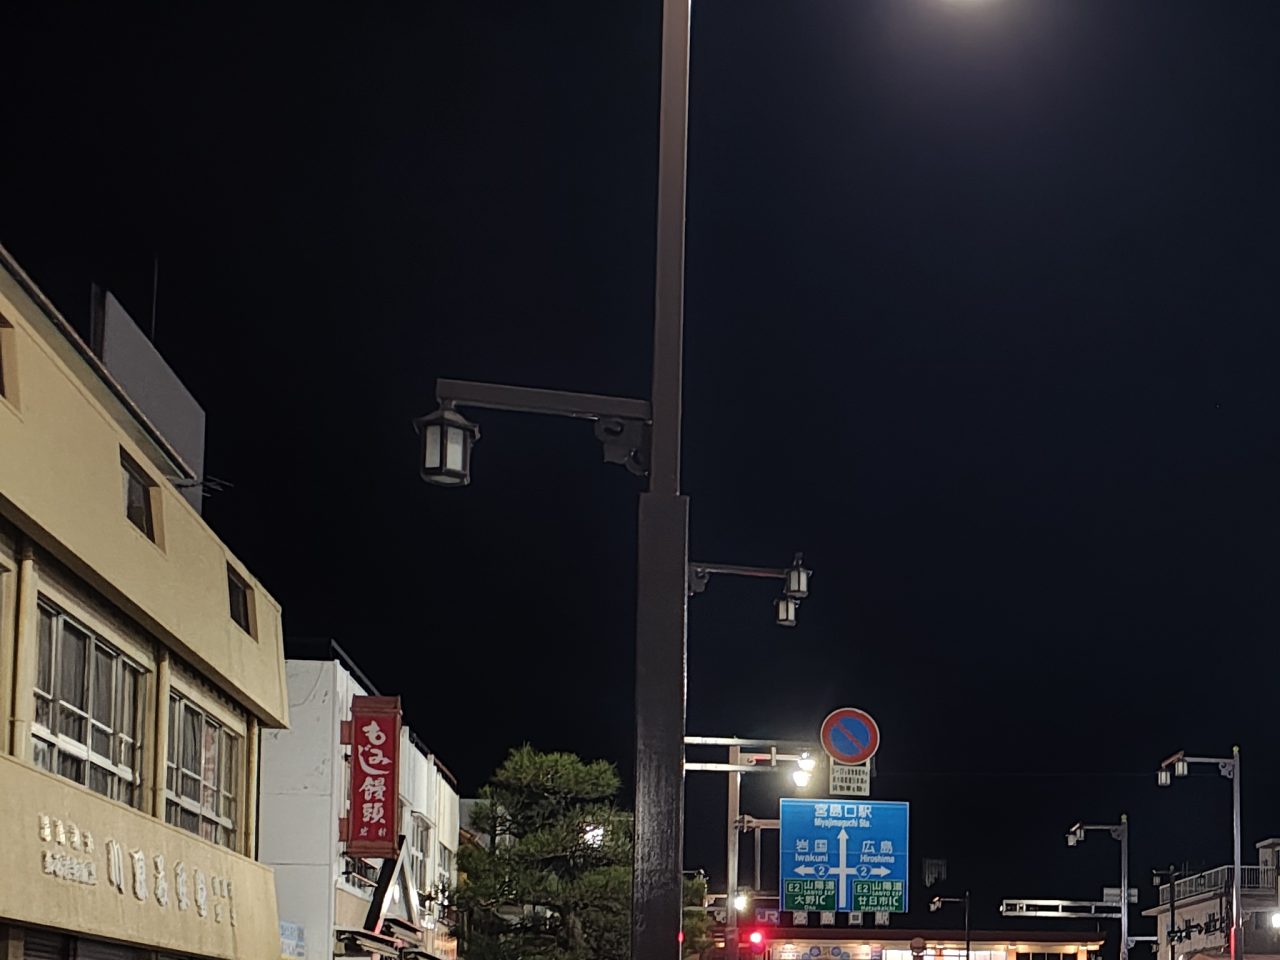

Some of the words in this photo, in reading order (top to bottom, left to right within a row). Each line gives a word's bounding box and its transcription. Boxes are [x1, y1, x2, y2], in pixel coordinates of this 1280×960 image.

[357, 719, 392, 824] もみじ饅頭
[815, 804, 872, 818] 宮島口駅
[797, 839, 827, 852] 岩国
[862, 840, 892, 853] 広島
[795, 853, 828, 862] Iwakuni
[860, 854, 895, 863] Hiroshima
[818, 867, 825, 876] 2
[860, 868, 868, 876] 2
[788, 884, 800, 892] E2
[804, 881, 834, 890] 山陽道
[857, 885, 868, 893] E2
[872, 882, 902, 891] 山陽道
[795, 895, 826, 905] 大野IC
[858, 896, 899, 906] 廿日市IC
[757, 911, 777, 922] JR
